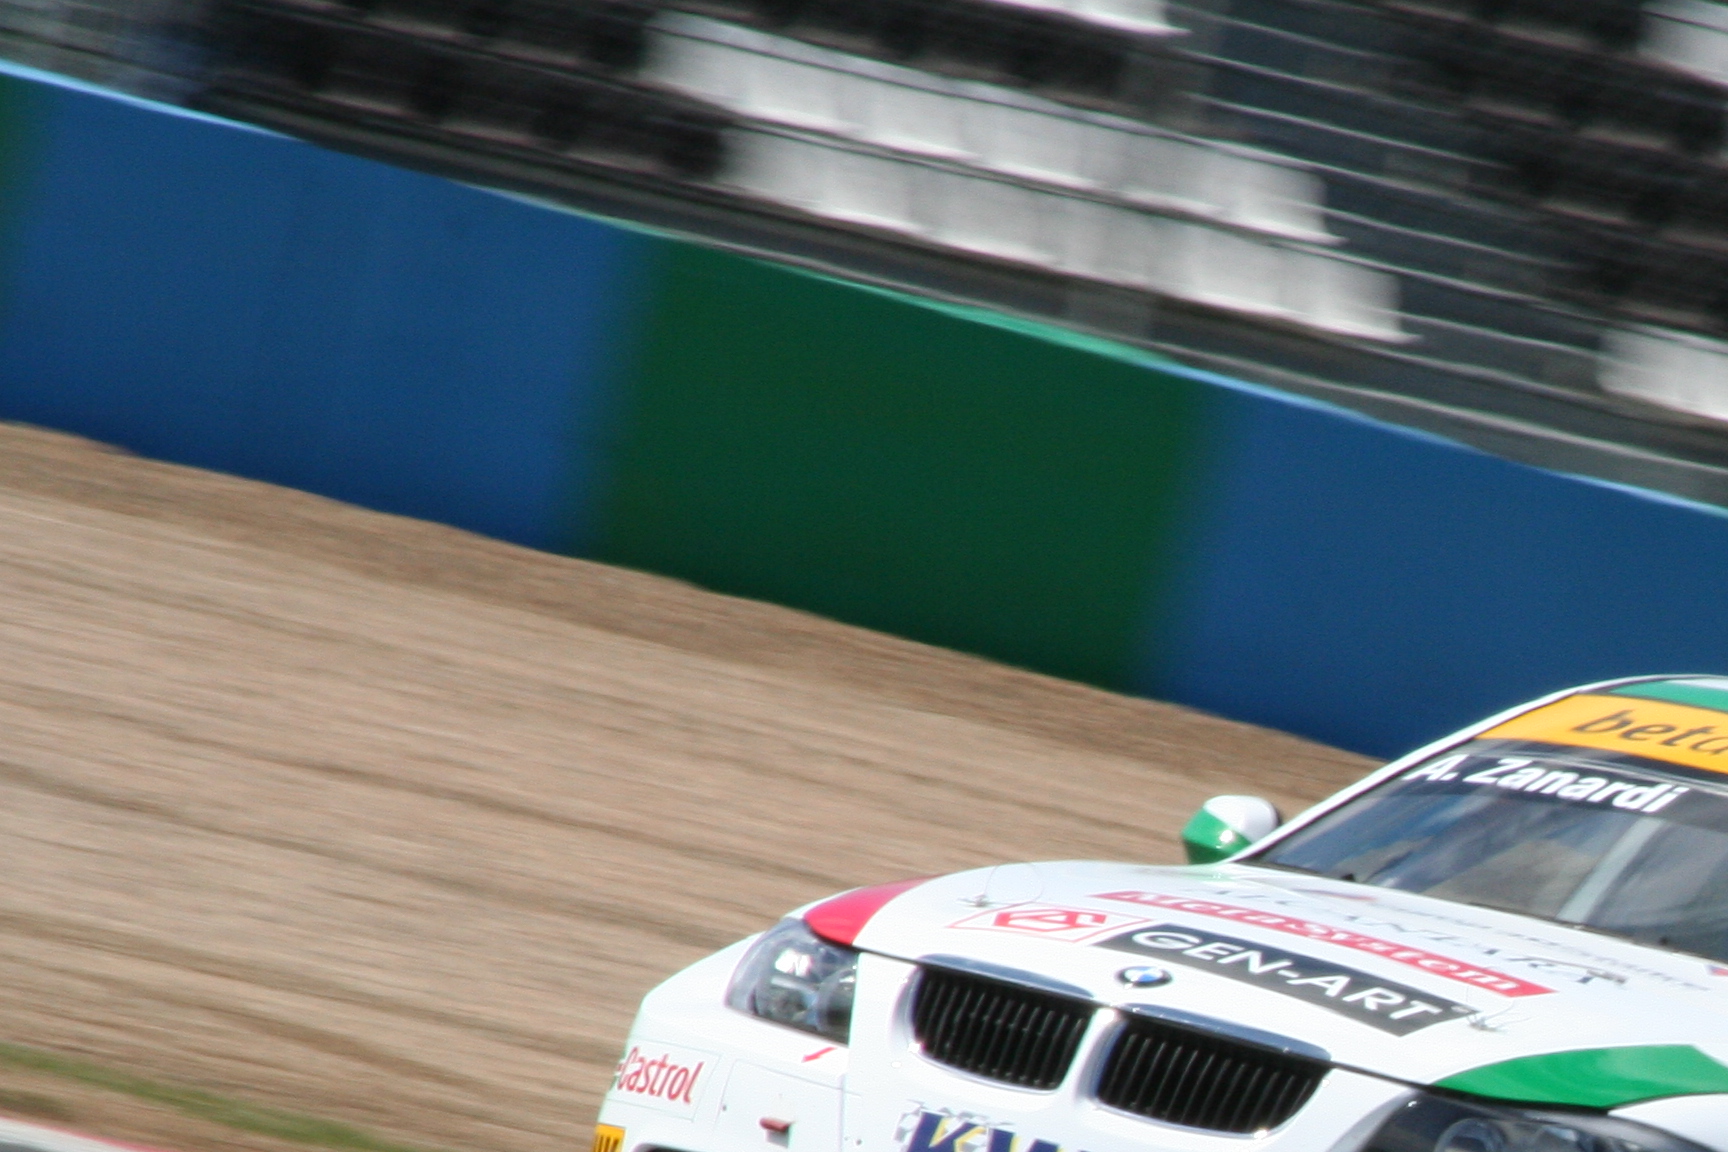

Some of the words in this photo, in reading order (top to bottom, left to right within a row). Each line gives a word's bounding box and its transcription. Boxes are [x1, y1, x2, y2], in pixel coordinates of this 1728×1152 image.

[1402, 753, 1467, 782] A.
[1463, 758, 1690, 813] Zanardi
[1131, 930, 1444, 1021] GEN-ART
